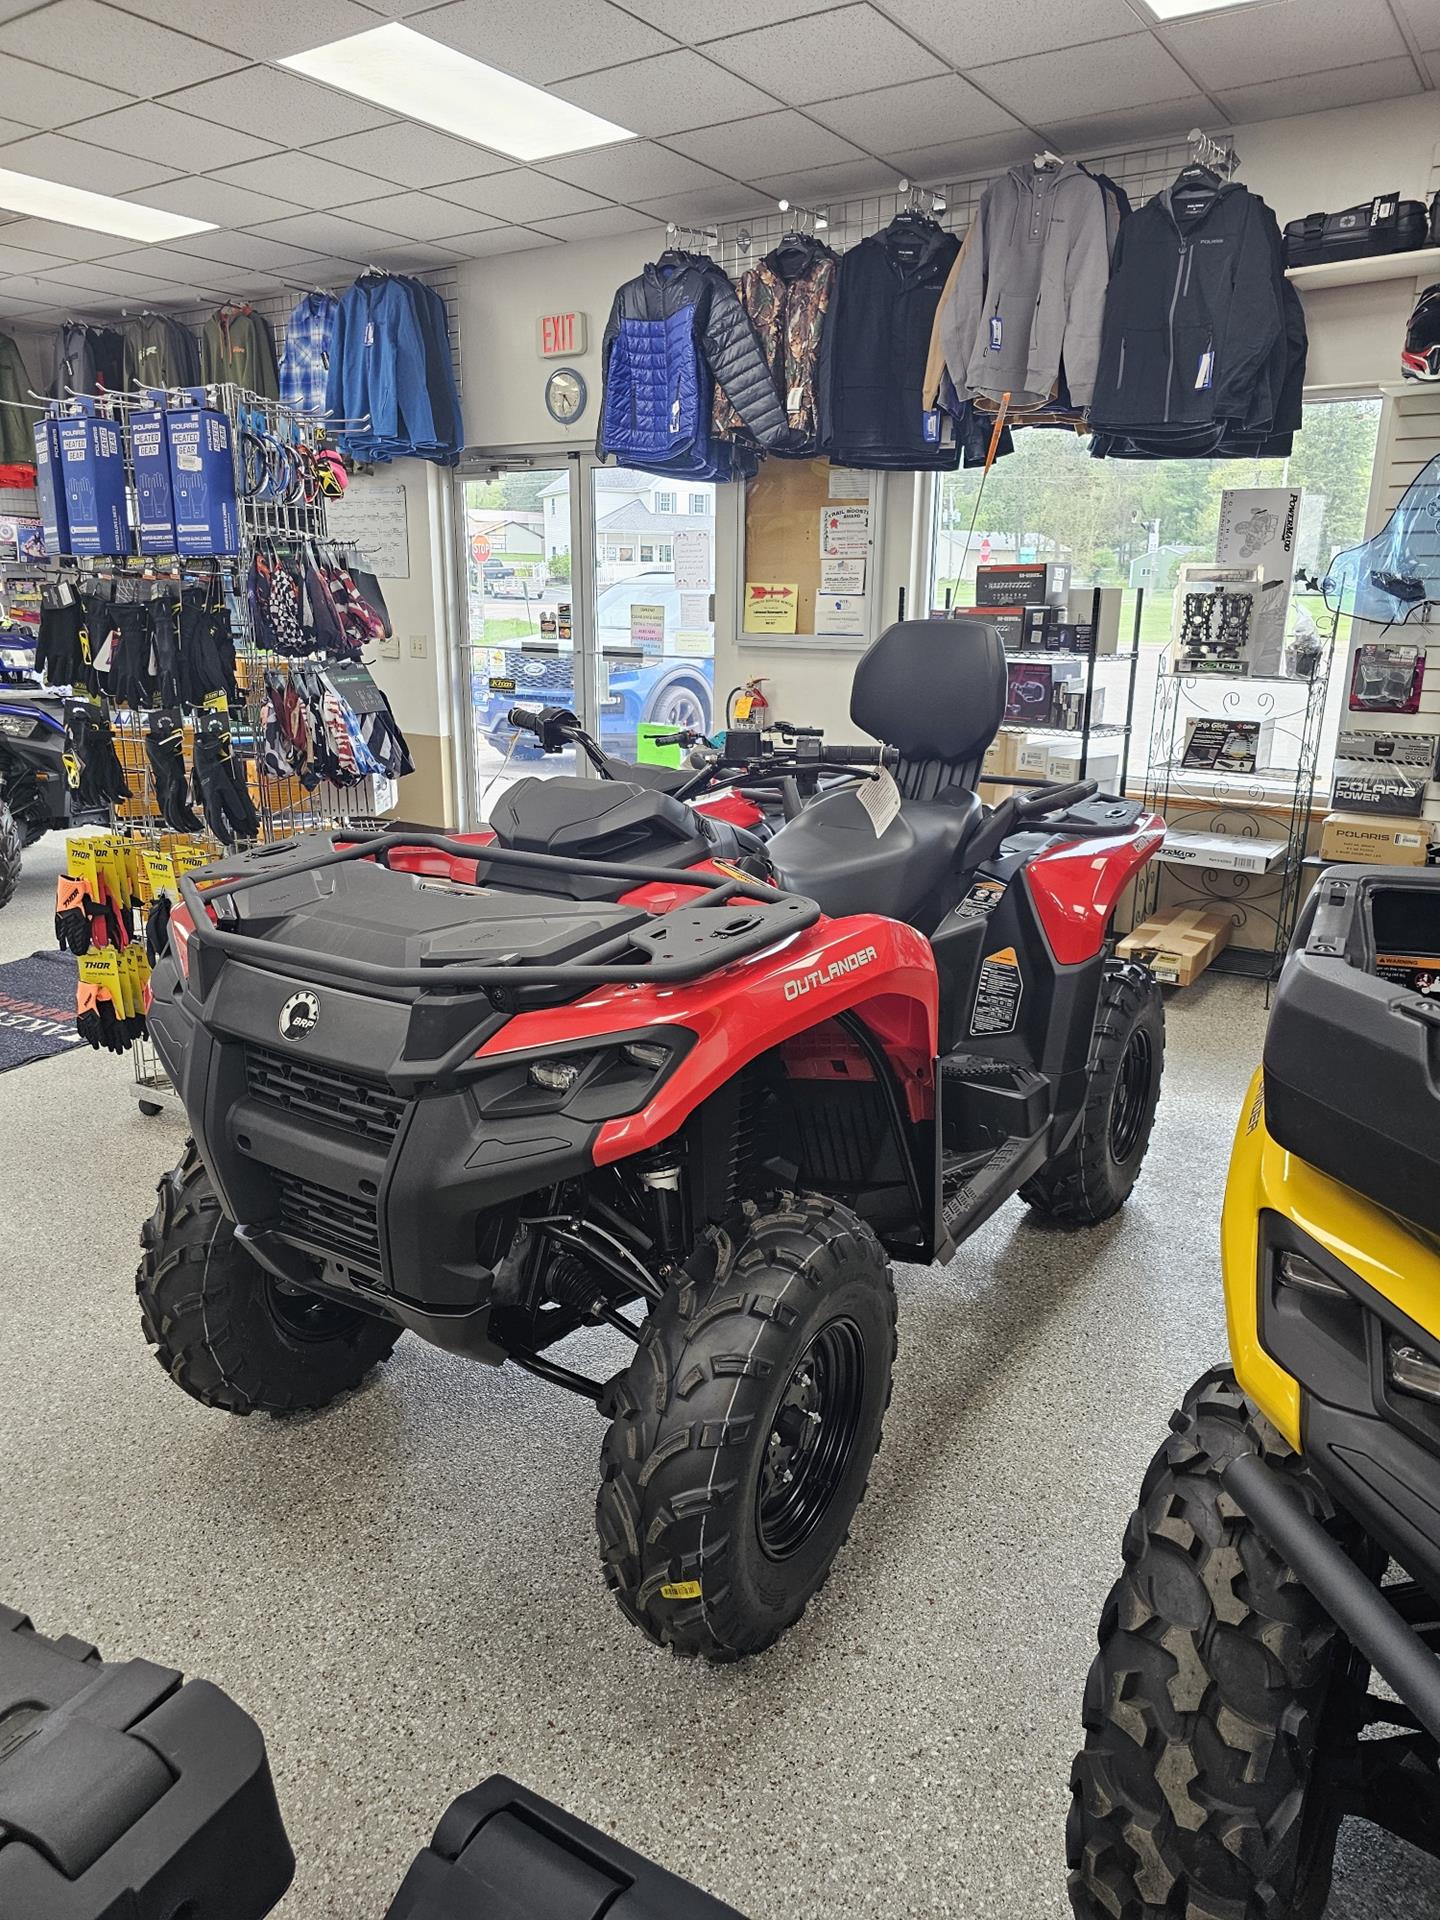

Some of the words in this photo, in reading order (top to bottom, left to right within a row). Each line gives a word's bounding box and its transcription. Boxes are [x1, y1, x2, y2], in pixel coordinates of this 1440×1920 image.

[1370, 198, 1381, 227] POLARIS
[542, 313, 575, 353] EXIT
[132, 422, 160, 431] POLARIS
[171, 422, 199, 430] POLARIS
[61, 429, 86, 437] POLARIS
[135, 433, 159, 442] HEATED
[174, 433, 198, 442] HEATED
[64, 440, 86, 448] HEATED
[100, 427, 109, 457] HEATED
[109, 431, 117, 454] GEAR
[140, 445, 158, 455] GEAR
[179, 445, 196, 454] GEAR
[69, 451, 84, 460] GEAR
[473, 544, 490, 554] STOP
[1211, 721, 1229, 729] Glide
[1336, 780, 1417, 798] POLARIS
[1335, 790, 1380, 802] POWER
[1336, 829, 1390, 841] POLARIS
[71, 849, 91, 860] THOR
[149, 862, 169, 871] THOR
[180, 856, 202, 867] THOR
[63, 888, 80, 908] THOR
[84, 961, 111, 970] THOR
[1385, 957, 1418, 965] WARNING
[783, 945, 878, 1002] OUTLANDER
[292, 1016, 315, 1028] BRP
